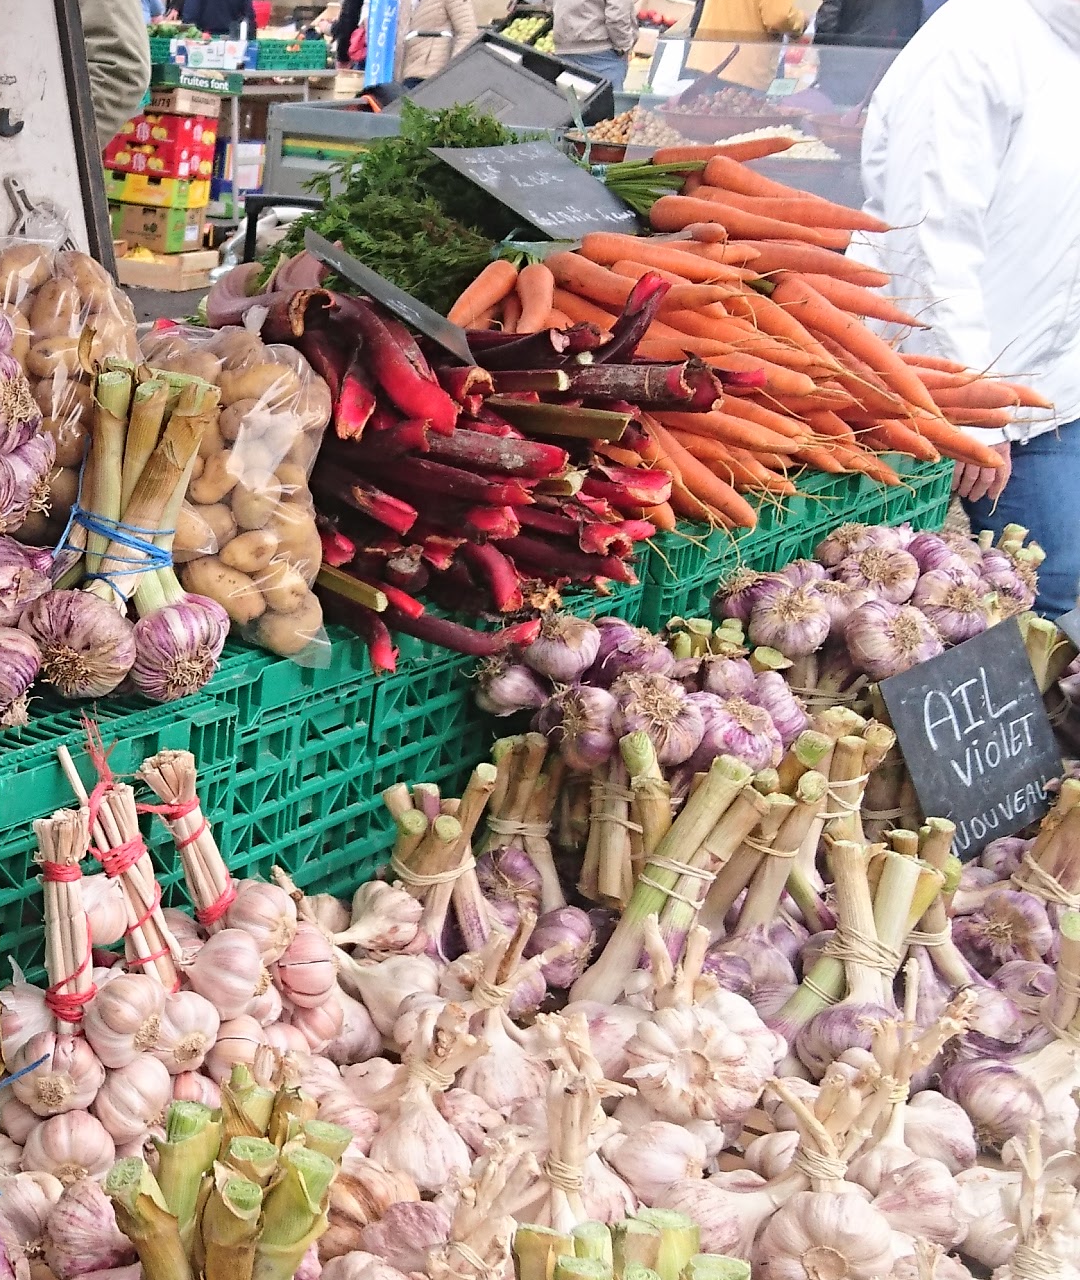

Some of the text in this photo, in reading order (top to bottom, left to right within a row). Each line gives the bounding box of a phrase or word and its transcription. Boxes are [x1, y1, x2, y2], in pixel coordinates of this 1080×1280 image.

[211, 78, 229, 91] font
[924, 666, 1017, 751] AIL
[951, 775, 1048, 858] NOUVEAU
